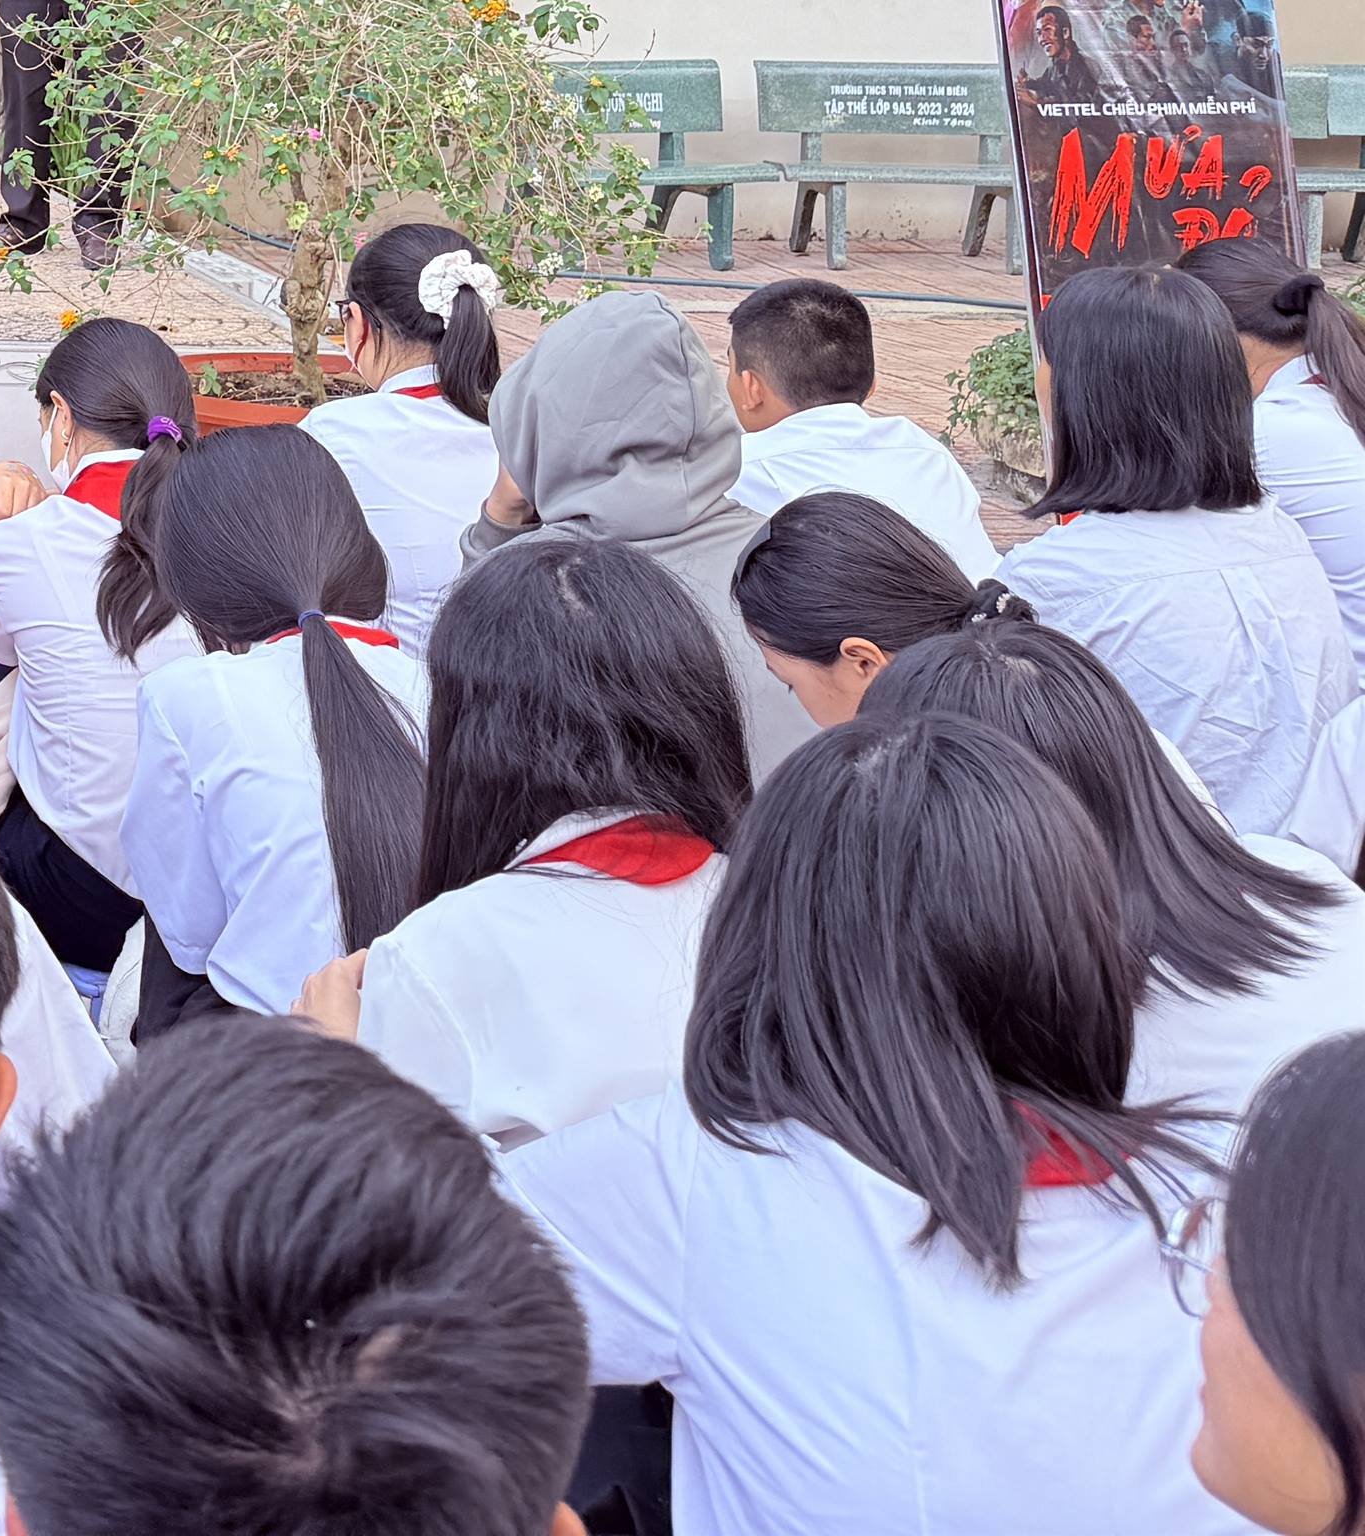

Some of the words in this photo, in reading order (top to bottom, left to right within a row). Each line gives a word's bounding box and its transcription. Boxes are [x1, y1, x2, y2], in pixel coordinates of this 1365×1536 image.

[865, 85, 887, 96] THCS
[917, 102, 942, 116] 2023
[950, 102, 975, 116] 2024
[1037, 102, 1101, 117] VIETTEL
[1102, 96, 1146, 116] CHIẾU
[1148, 102, 1187, 115] PHIM
[1188, 96, 1229, 115] MIỄN
[1230, 96, 1257, 115] PHÍ
[1049, 124, 1229, 259] MƯA
